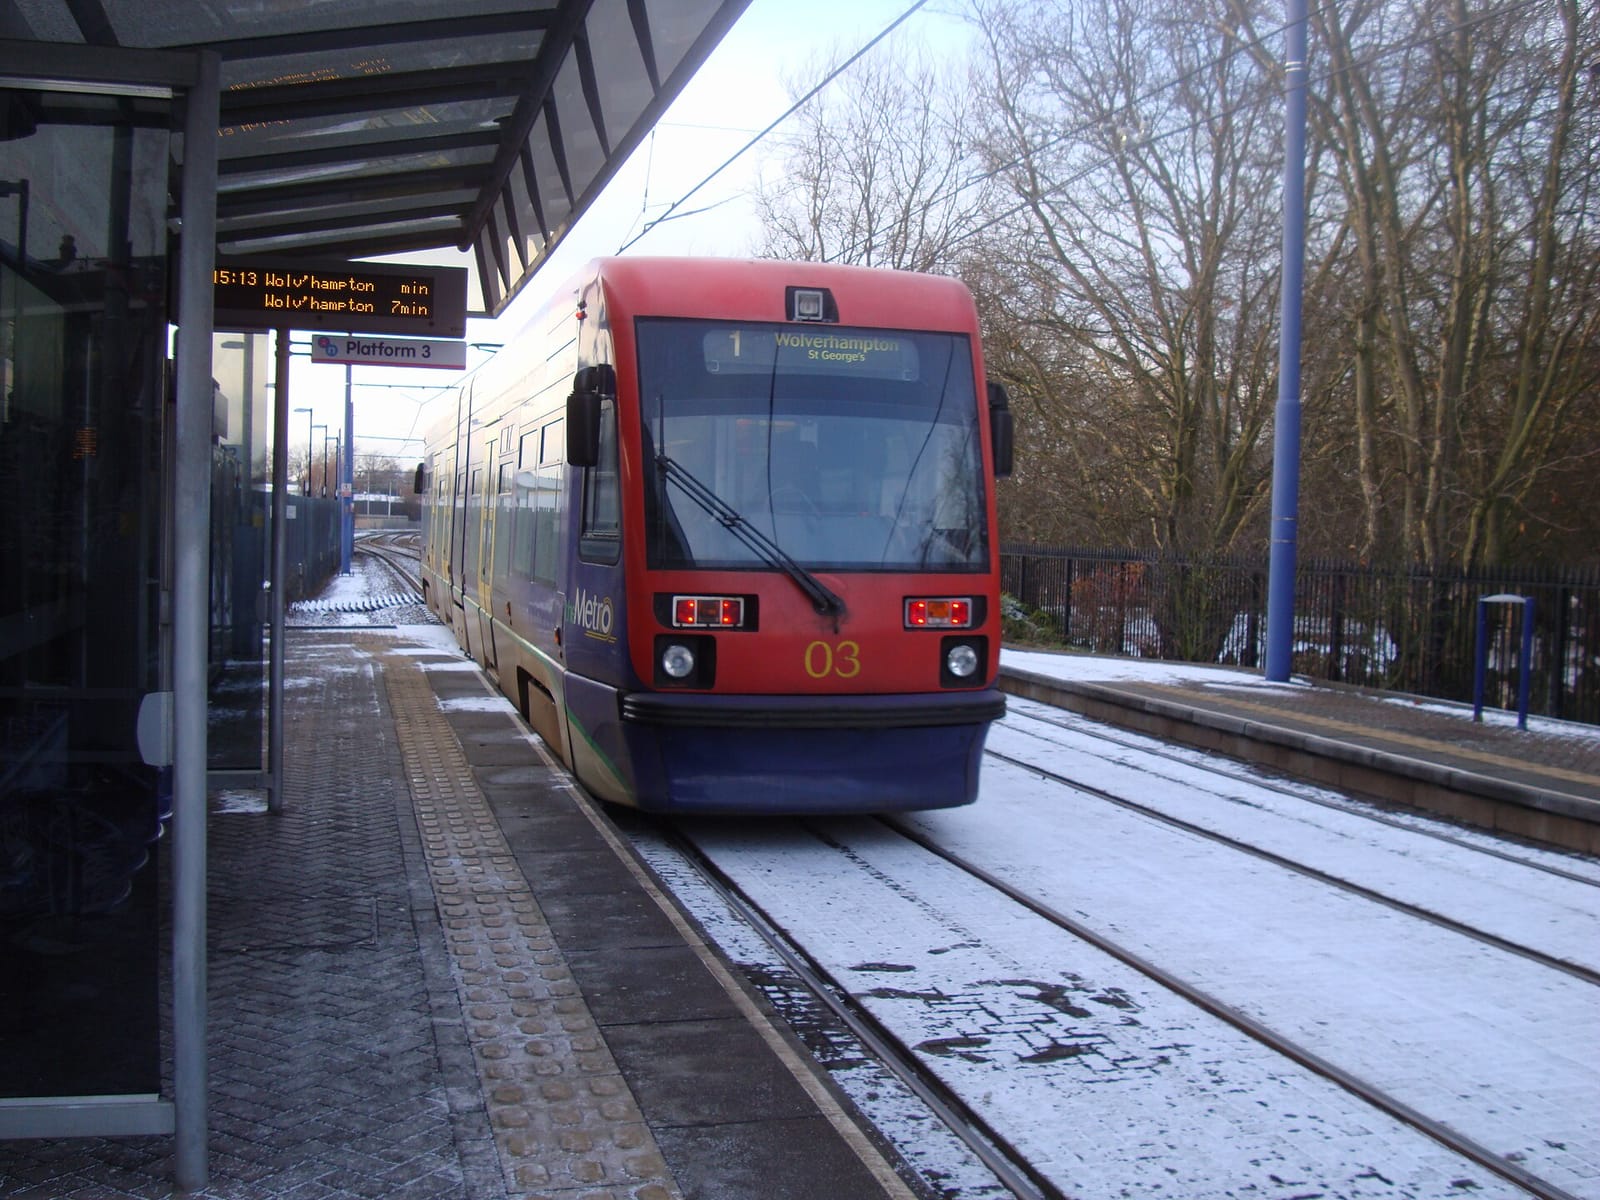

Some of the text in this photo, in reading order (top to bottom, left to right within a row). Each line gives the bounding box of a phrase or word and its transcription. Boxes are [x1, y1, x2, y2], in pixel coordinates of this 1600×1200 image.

[213, 270, 428, 296] 15:13 Wolv'hampton min
[265, 294, 428, 316] Wolv'hampton 7min
[346, 341, 431, 359] Platform 3
[729, 330, 899, 357] 1 Wolverhampton
[808, 350, 865, 363] St George's
[573, 587, 612, 634] Metro
[803, 640, 861, 679] 03
